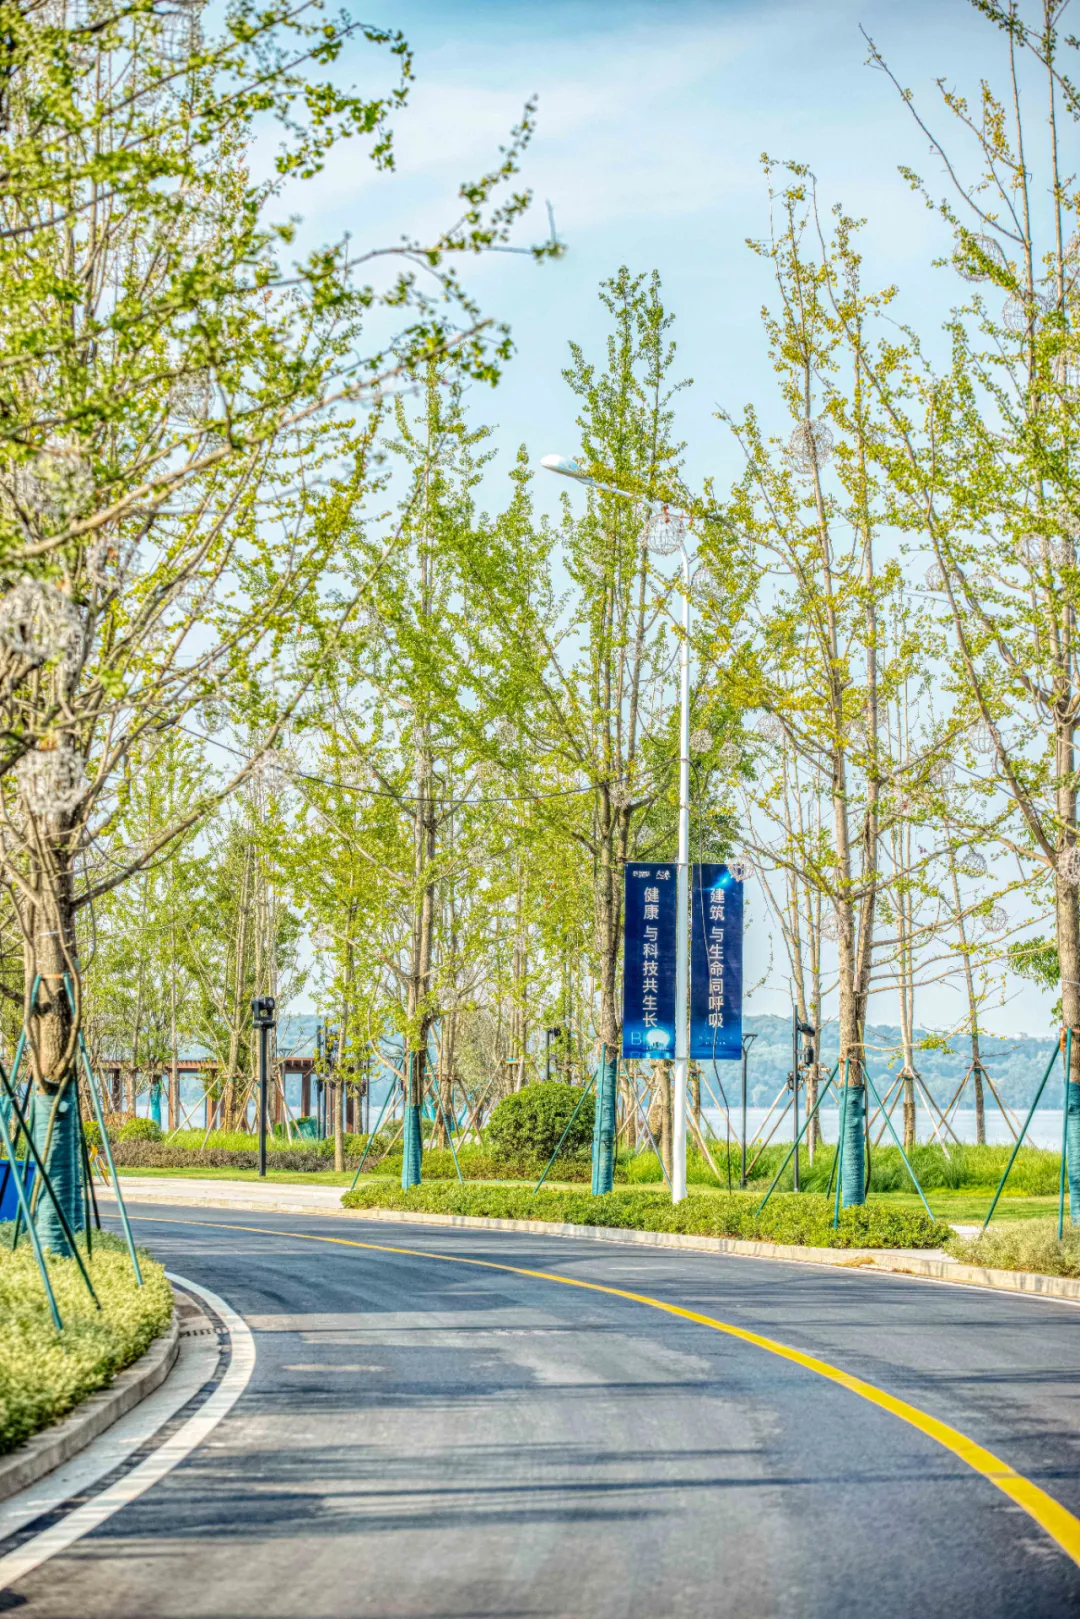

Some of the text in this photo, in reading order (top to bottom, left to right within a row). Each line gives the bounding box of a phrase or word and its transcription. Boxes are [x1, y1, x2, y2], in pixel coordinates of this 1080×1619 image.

[643, 887, 659, 1028] 健康与科技共生长
[708, 888, 725, 1028] 建筑与生命同呼吸
